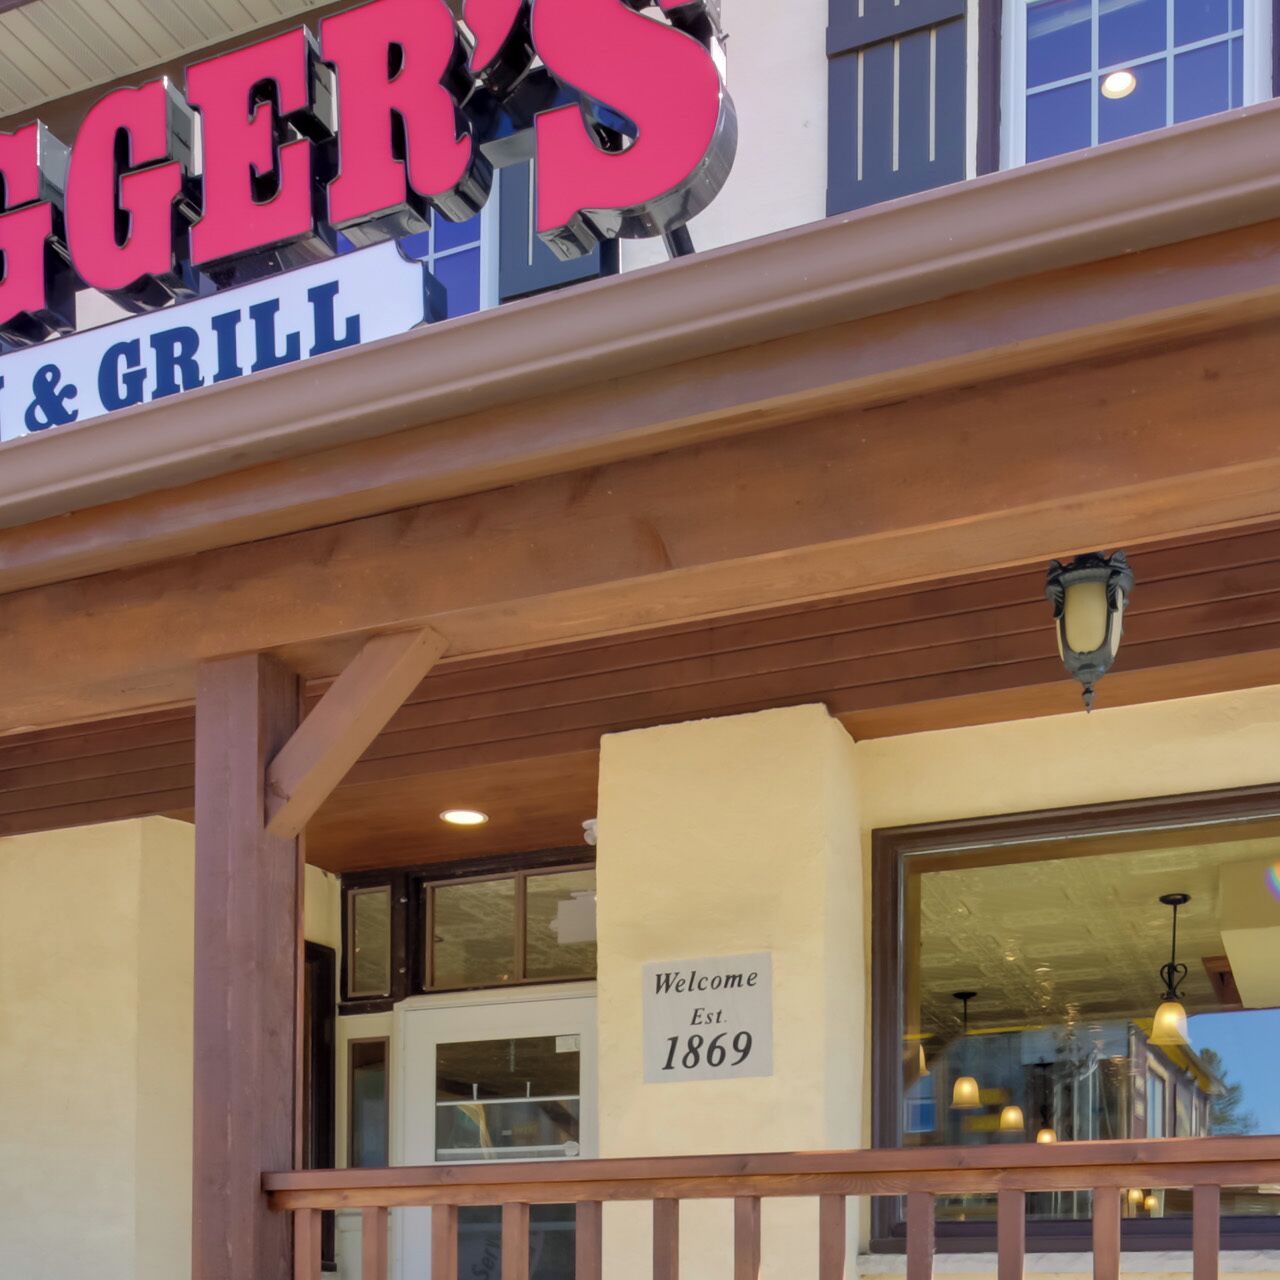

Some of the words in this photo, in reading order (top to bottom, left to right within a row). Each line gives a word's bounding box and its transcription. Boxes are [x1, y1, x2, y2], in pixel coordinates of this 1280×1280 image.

[23, 362, 80, 433] &
[97, 279, 362, 413] GRILL
[654, 970, 759, 995] Welcome
[661, 1030, 753, 1071] 1869
